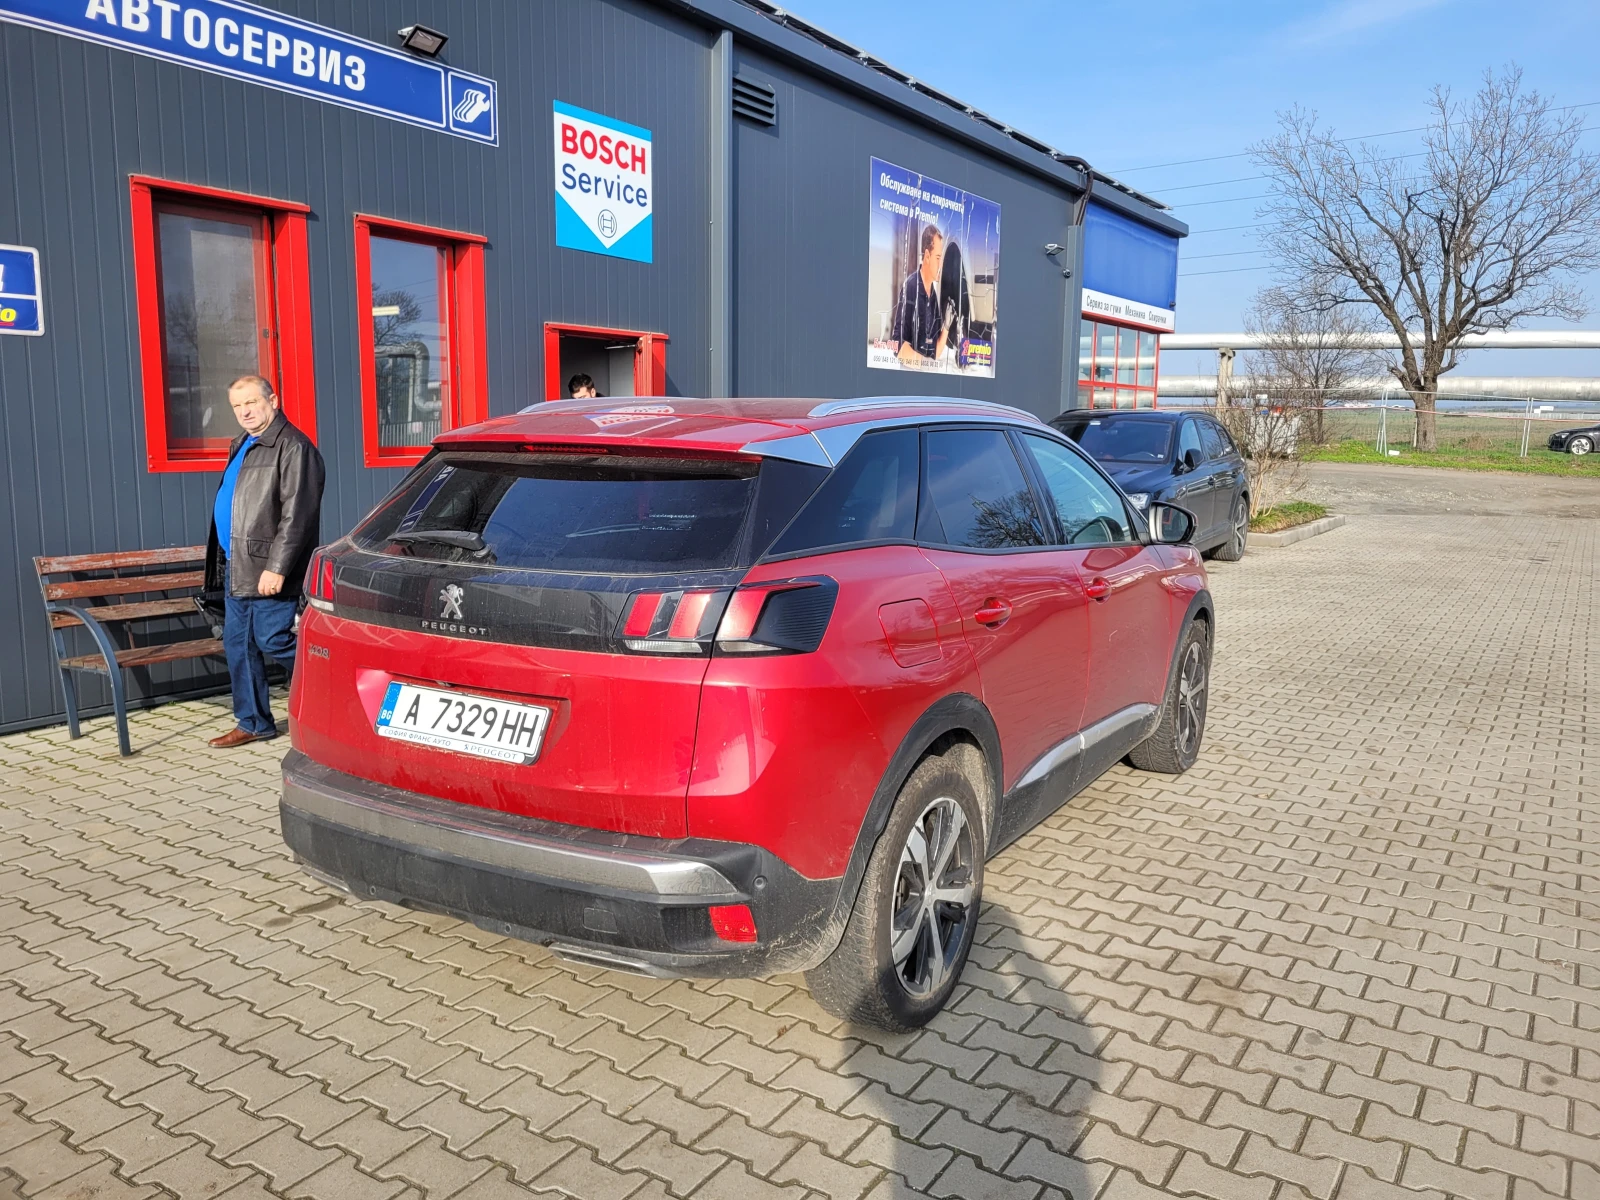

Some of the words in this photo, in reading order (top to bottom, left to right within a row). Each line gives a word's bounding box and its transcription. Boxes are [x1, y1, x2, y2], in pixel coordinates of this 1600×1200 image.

[84, 0, 366, 91] АВТОСЕРВИЗ
[561, 122, 646, 175] BOSCH
[561, 163, 648, 207] Service
[880, 172, 922, 199] Обслужване
[922, 190, 931, 202] на
[880, 199, 909, 216] система
[1086, 295, 1103, 310] Сервиз
[1103, 302, 1109, 312] за
[968, 344, 992, 356] premio
[422, 621, 487, 635] PEUGEOT
[381, 708, 393, 721] BG
[403, 693, 421, 726] A
[384, 728, 408, 739] СОФИЯ
[408, 732, 432, 743] ФРАНС
[432, 738, 452, 748] АУТО
[470, 745, 519, 761] PEUGEOT
